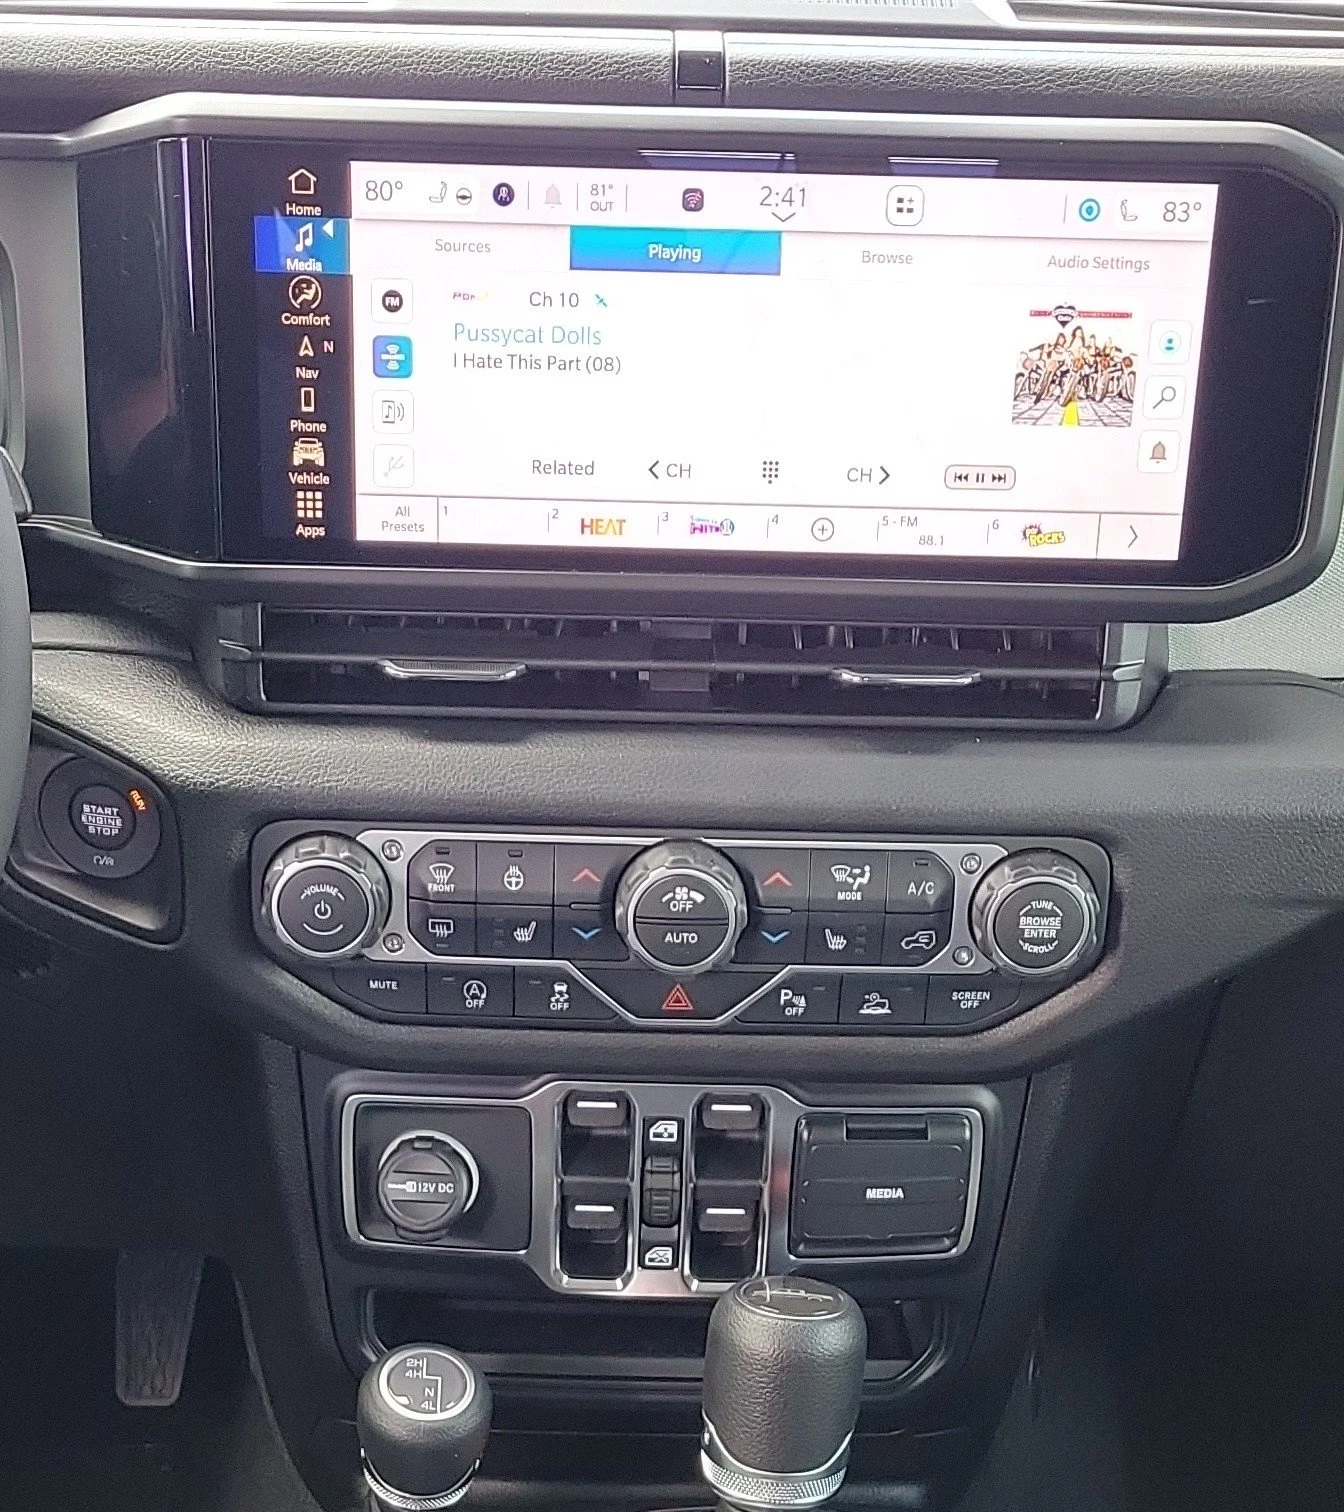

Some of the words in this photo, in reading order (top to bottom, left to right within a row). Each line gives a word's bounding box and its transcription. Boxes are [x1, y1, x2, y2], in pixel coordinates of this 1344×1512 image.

[759, 186, 808, 208] 2:41
[285, 202, 322, 217] Home
[589, 200, 615, 212] OUT
[434, 238, 492, 254] Sources
[648, 244, 702, 263] Playing
[861, 250, 914, 265] Browse
[285, 257, 323, 273] Media
[1047, 255, 1090, 270] Audio
[1092, 256, 1151, 273] Settings
[384, 295, 400, 308] FM
[529, 291, 553, 307] Ch
[559, 292, 580, 308] 10
[280, 312, 331, 327] Comfort
[453, 322, 545, 347] Pussycat
[551, 325, 603, 346] Dolls
[322, 340, 335, 354] N
[463, 352, 503, 369] Hate
[506, 353, 542, 370] This
[547, 354, 582, 371] Part
[585, 354, 622, 376] (08)
[295, 366, 319, 380] Nav
[290, 419, 327, 434] Phone
[532, 459, 595, 476] Related
[666, 462, 692, 479] CH
[288, 471, 331, 486] Vehicle
[846, 467, 873, 483] CH
[394, 505, 411, 518] All
[551, 508, 560, 520] 2
[662, 511, 669, 522] 3
[772, 513, 779, 525] 4
[881, 516, 890, 527] 5
[900, 516, 919, 528] FM
[992, 519, 1000, 531] 6
[295, 524, 326, 539] Apps
[380, 520, 426, 534] Presets
[580, 517, 626, 536] HEAT
[918, 534, 945, 547] 88.1
[130, 789, 146, 811] RUN
[82, 803, 120, 816] START
[81, 814, 124, 828] ENGINE
[88, 826, 119, 836] STOP
[304, 884, 340, 897] VOLUME
[428, 882, 456, 893] FRONT
[907, 880, 936, 896] A/C
[837, 891, 862, 902] MODE
[670, 901, 694, 912] OFF
[1030, 899, 1055, 910] TUNE
[1019, 916, 1062, 926] BROWSE
[664, 932, 698, 944] AUTO
[1024, 928, 1057, 939] ENTER
[1022, 942, 1056, 954] SCROLL
[369, 980, 398, 990] MUTE
[780, 989, 792, 1006] P
[952, 990, 991, 1002] SCREEN
[465, 998, 486, 1009] OFF
[550, 1002, 570, 1012] OFF
[960, 1000, 980, 1010] OFF
[784, 1007, 806, 1016] OFF
[418, 1182, 437, 1194] 12V
[438, 1182, 454, 1194] DC
[866, 1187, 905, 1199] MEDIA
[406, 1358, 423, 1368] 2H
[404, 1369, 423, 1380] 4H
[424, 1387, 435, 1398] N
[420, 1400, 436, 1411] 4L
